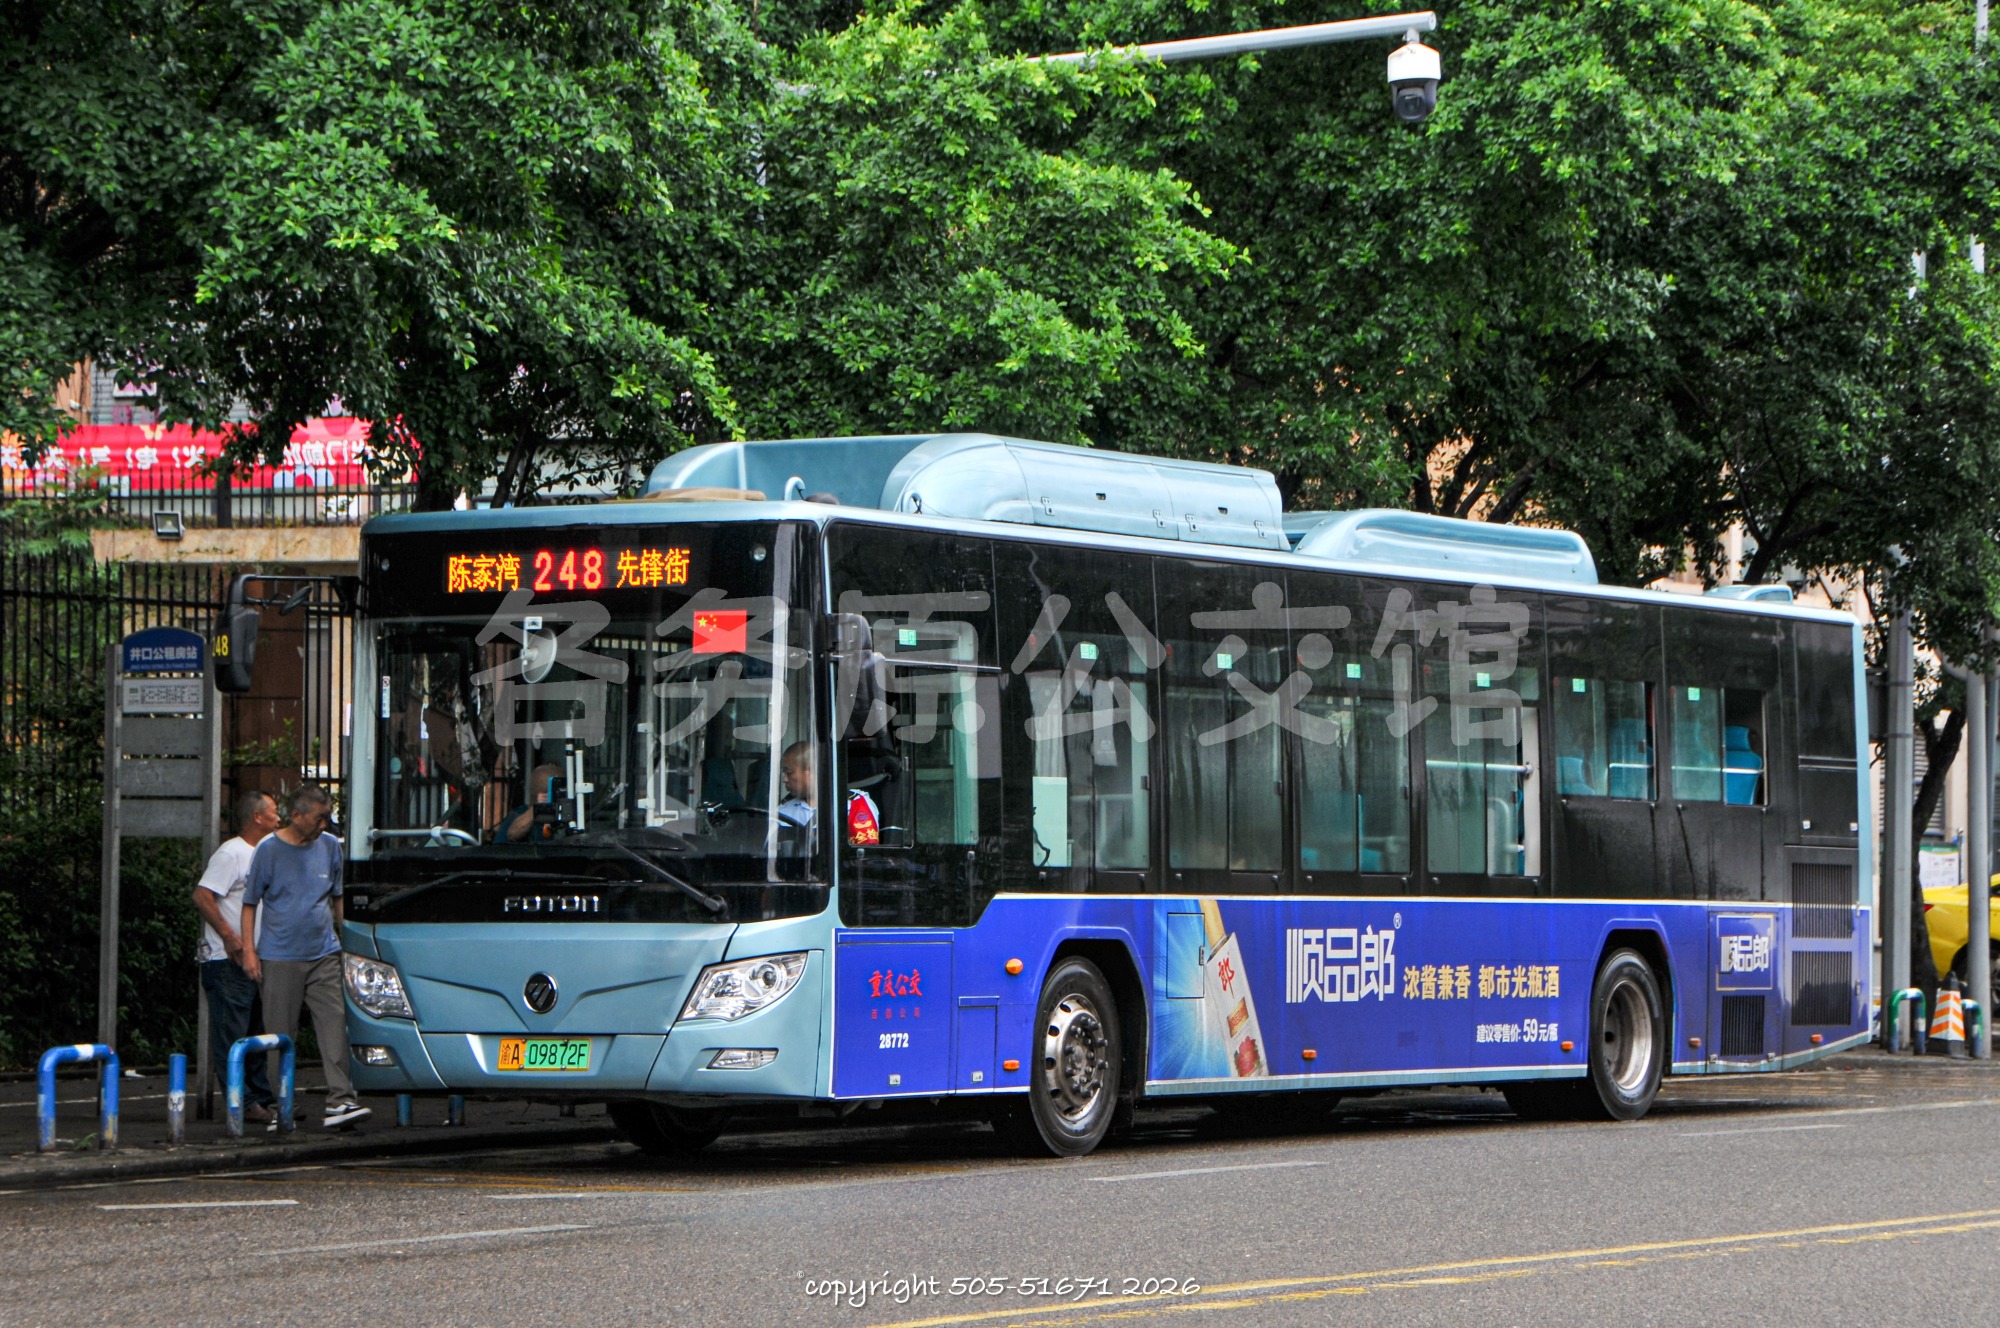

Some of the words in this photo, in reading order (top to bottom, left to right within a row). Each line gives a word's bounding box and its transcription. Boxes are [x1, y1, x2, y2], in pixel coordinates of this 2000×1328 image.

[449, 553, 520, 592] 陈家湾
[534, 549, 603, 591] 248
[616, 548, 690, 588] 先锋街
[504, 895, 599, 912] FOTON
[1720, 934, 1769, 972] 顺品郎
[868, 969, 922, 998] 重庆公交
[1403, 965, 1471, 1000] 浓酱兼香
[1478, 964, 1560, 999] 都市光瓶酒
[879, 1032, 909, 1049] 28772
